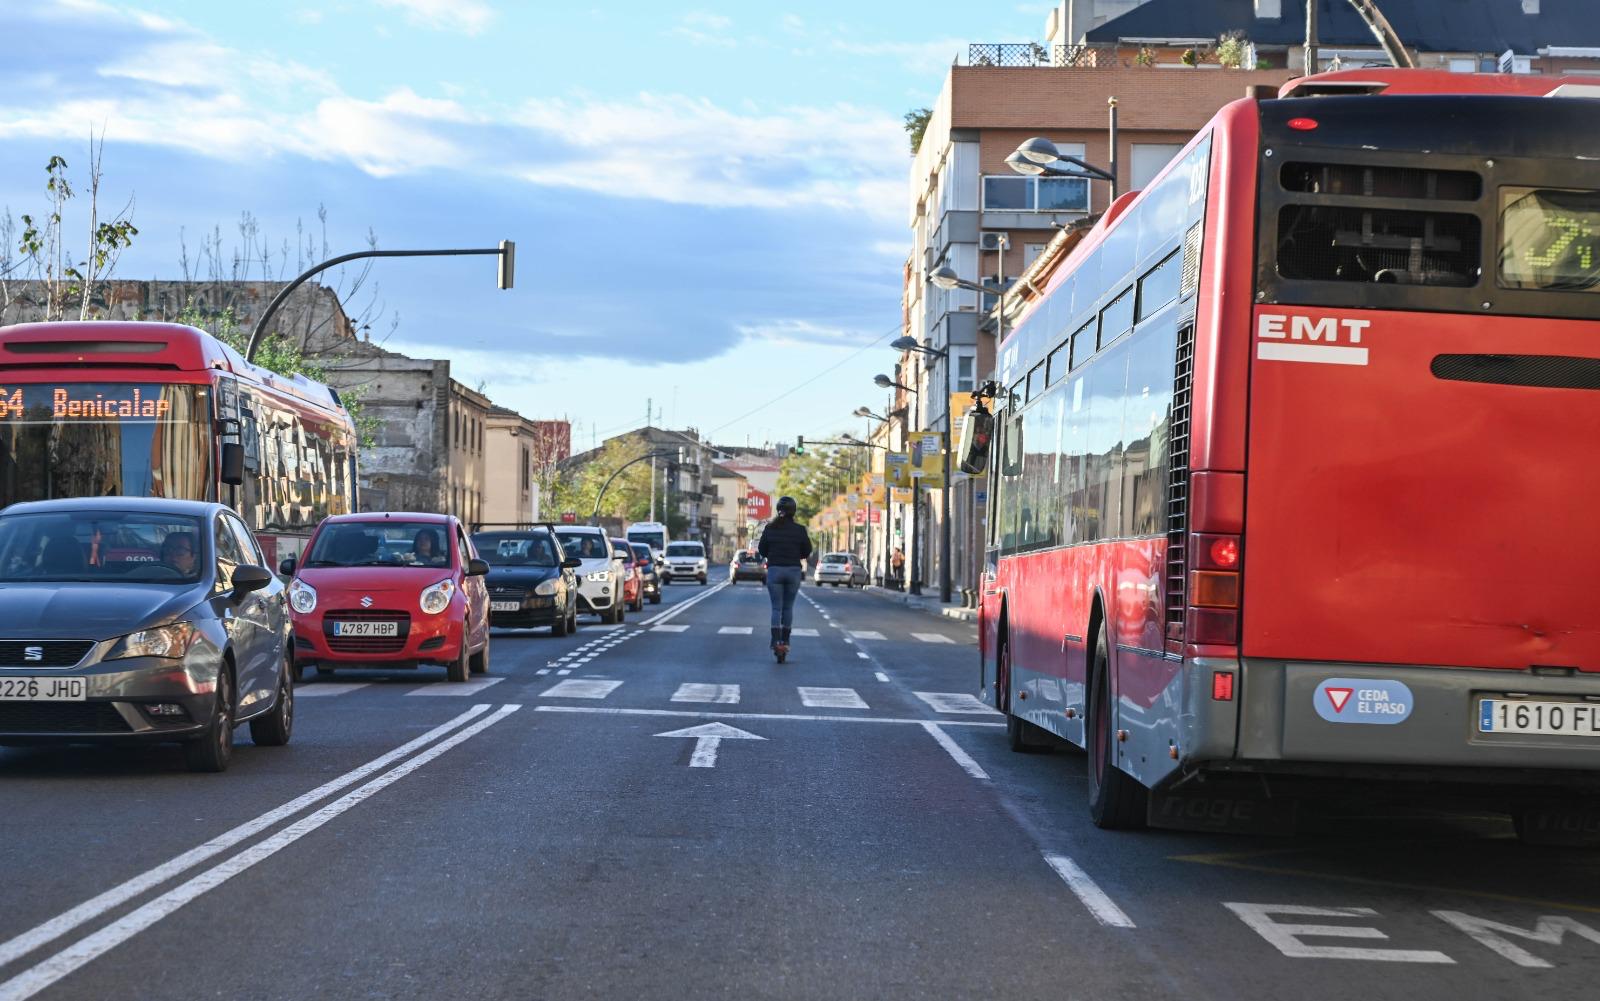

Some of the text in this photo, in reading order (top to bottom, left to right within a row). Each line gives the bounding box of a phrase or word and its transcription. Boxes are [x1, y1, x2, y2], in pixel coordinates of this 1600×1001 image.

[1258, 314, 1370, 343] EMT
[53, 388, 169, 417] Benicalap
[342, 624, 395, 634] 4787 HBP
[0, 680, 81, 698] 226 JHD
[1358, 689, 1390, 702] CEDA
[1358, 701, 1405, 715] EL PASO
[1501, 704, 1564, 730] 1610
